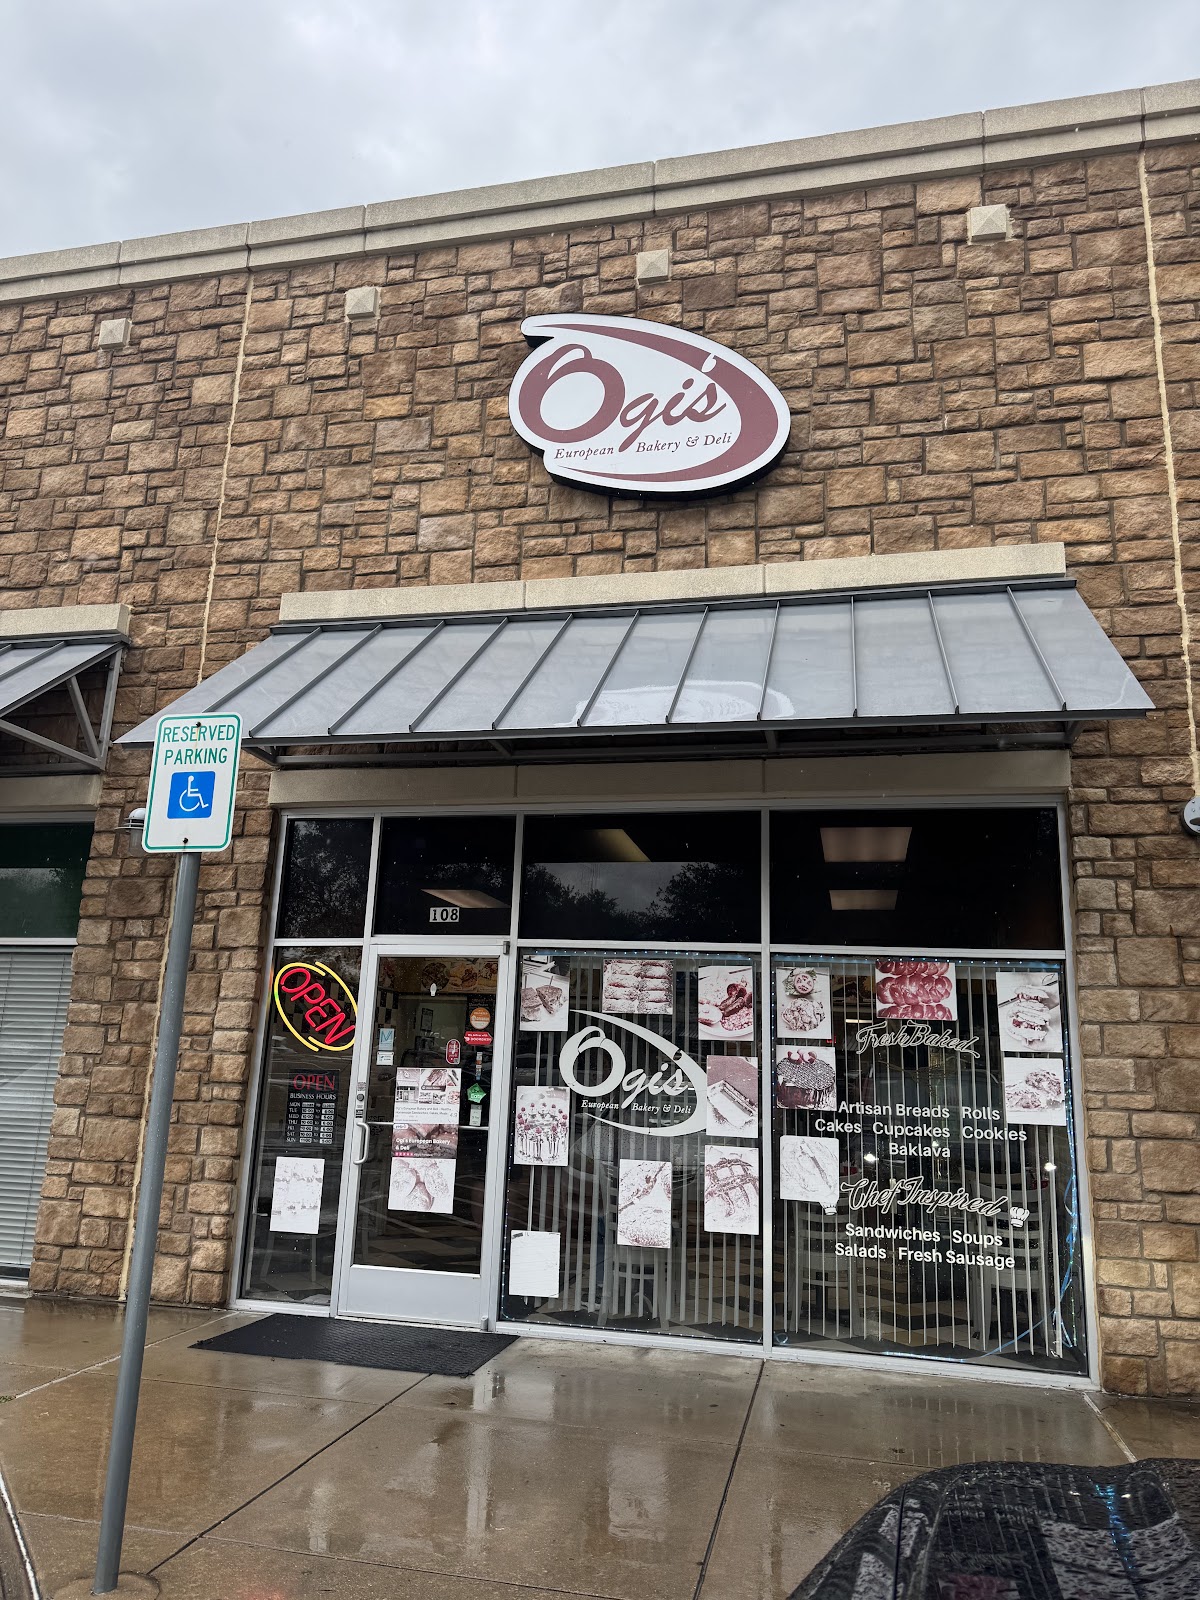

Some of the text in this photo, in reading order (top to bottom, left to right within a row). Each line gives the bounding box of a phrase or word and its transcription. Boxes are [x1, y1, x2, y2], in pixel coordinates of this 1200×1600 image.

[553, 432, 733, 461] European Bakery & Deli
[162, 724, 236, 743] RESERVED
[164, 747, 228, 765] PARKING
[432, 908, 459, 922] 108
[280, 967, 356, 1045] OPEN
[856, 1019, 980, 1059] Fresh Baked
[293, 1074, 336, 1091] OPEN
[289, 1092, 315, 1100] BUSINESS
[581, 1099, 692, 1115] European Bakery & Deli
[839, 1100, 1001, 1121] Artisan Breads Rolls
[815, 1119, 1028, 1142] Cakes Cupcakes Cookies
[888, 1142, 951, 1158] Baklava
[840, 1175, 1009, 1217] Chef Inspired
[845, 1222, 1003, 1248] Sandwiches Soups
[834, 1242, 1016, 1271] Salads Fresh Sausage
